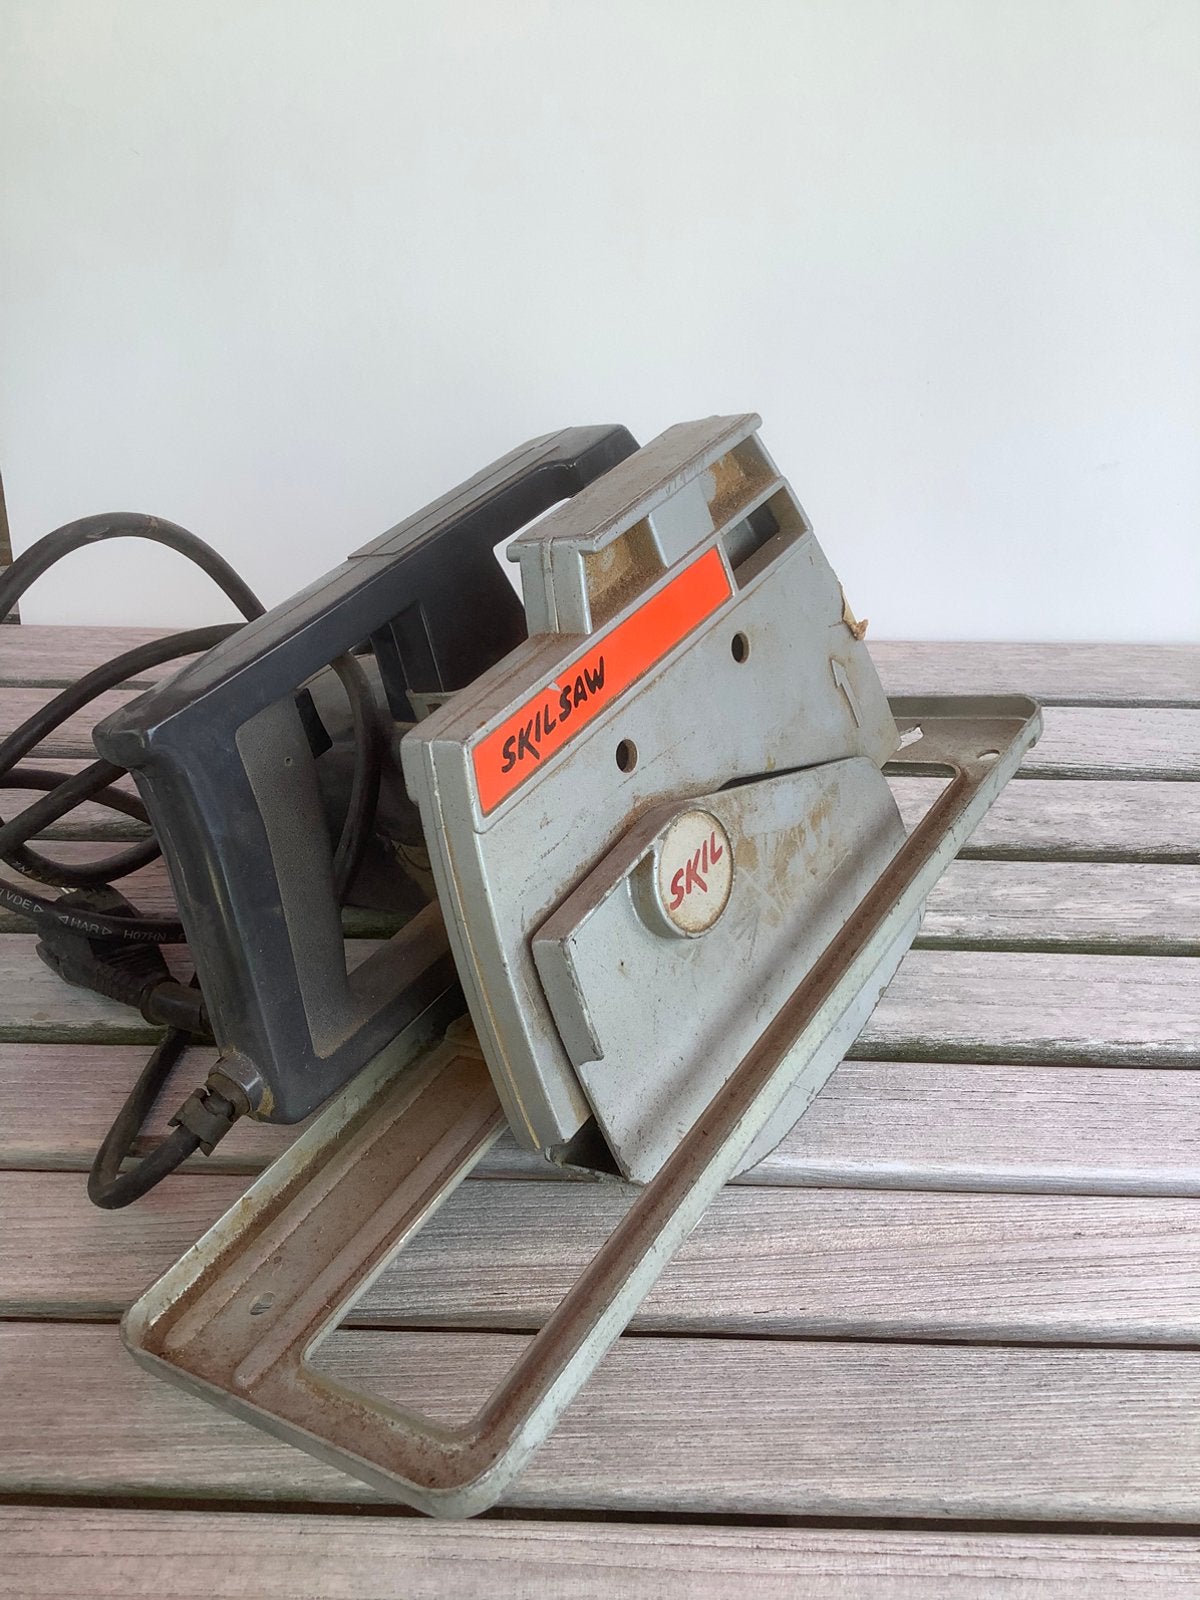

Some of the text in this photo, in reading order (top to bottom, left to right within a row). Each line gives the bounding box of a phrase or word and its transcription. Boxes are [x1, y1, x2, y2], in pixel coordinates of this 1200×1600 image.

[501, 655, 605, 773] SKILSAW
[669, 831, 723, 911] SKIL
[6, 890, 33, 910] VDE
[70, 917, 100, 935] HAR
